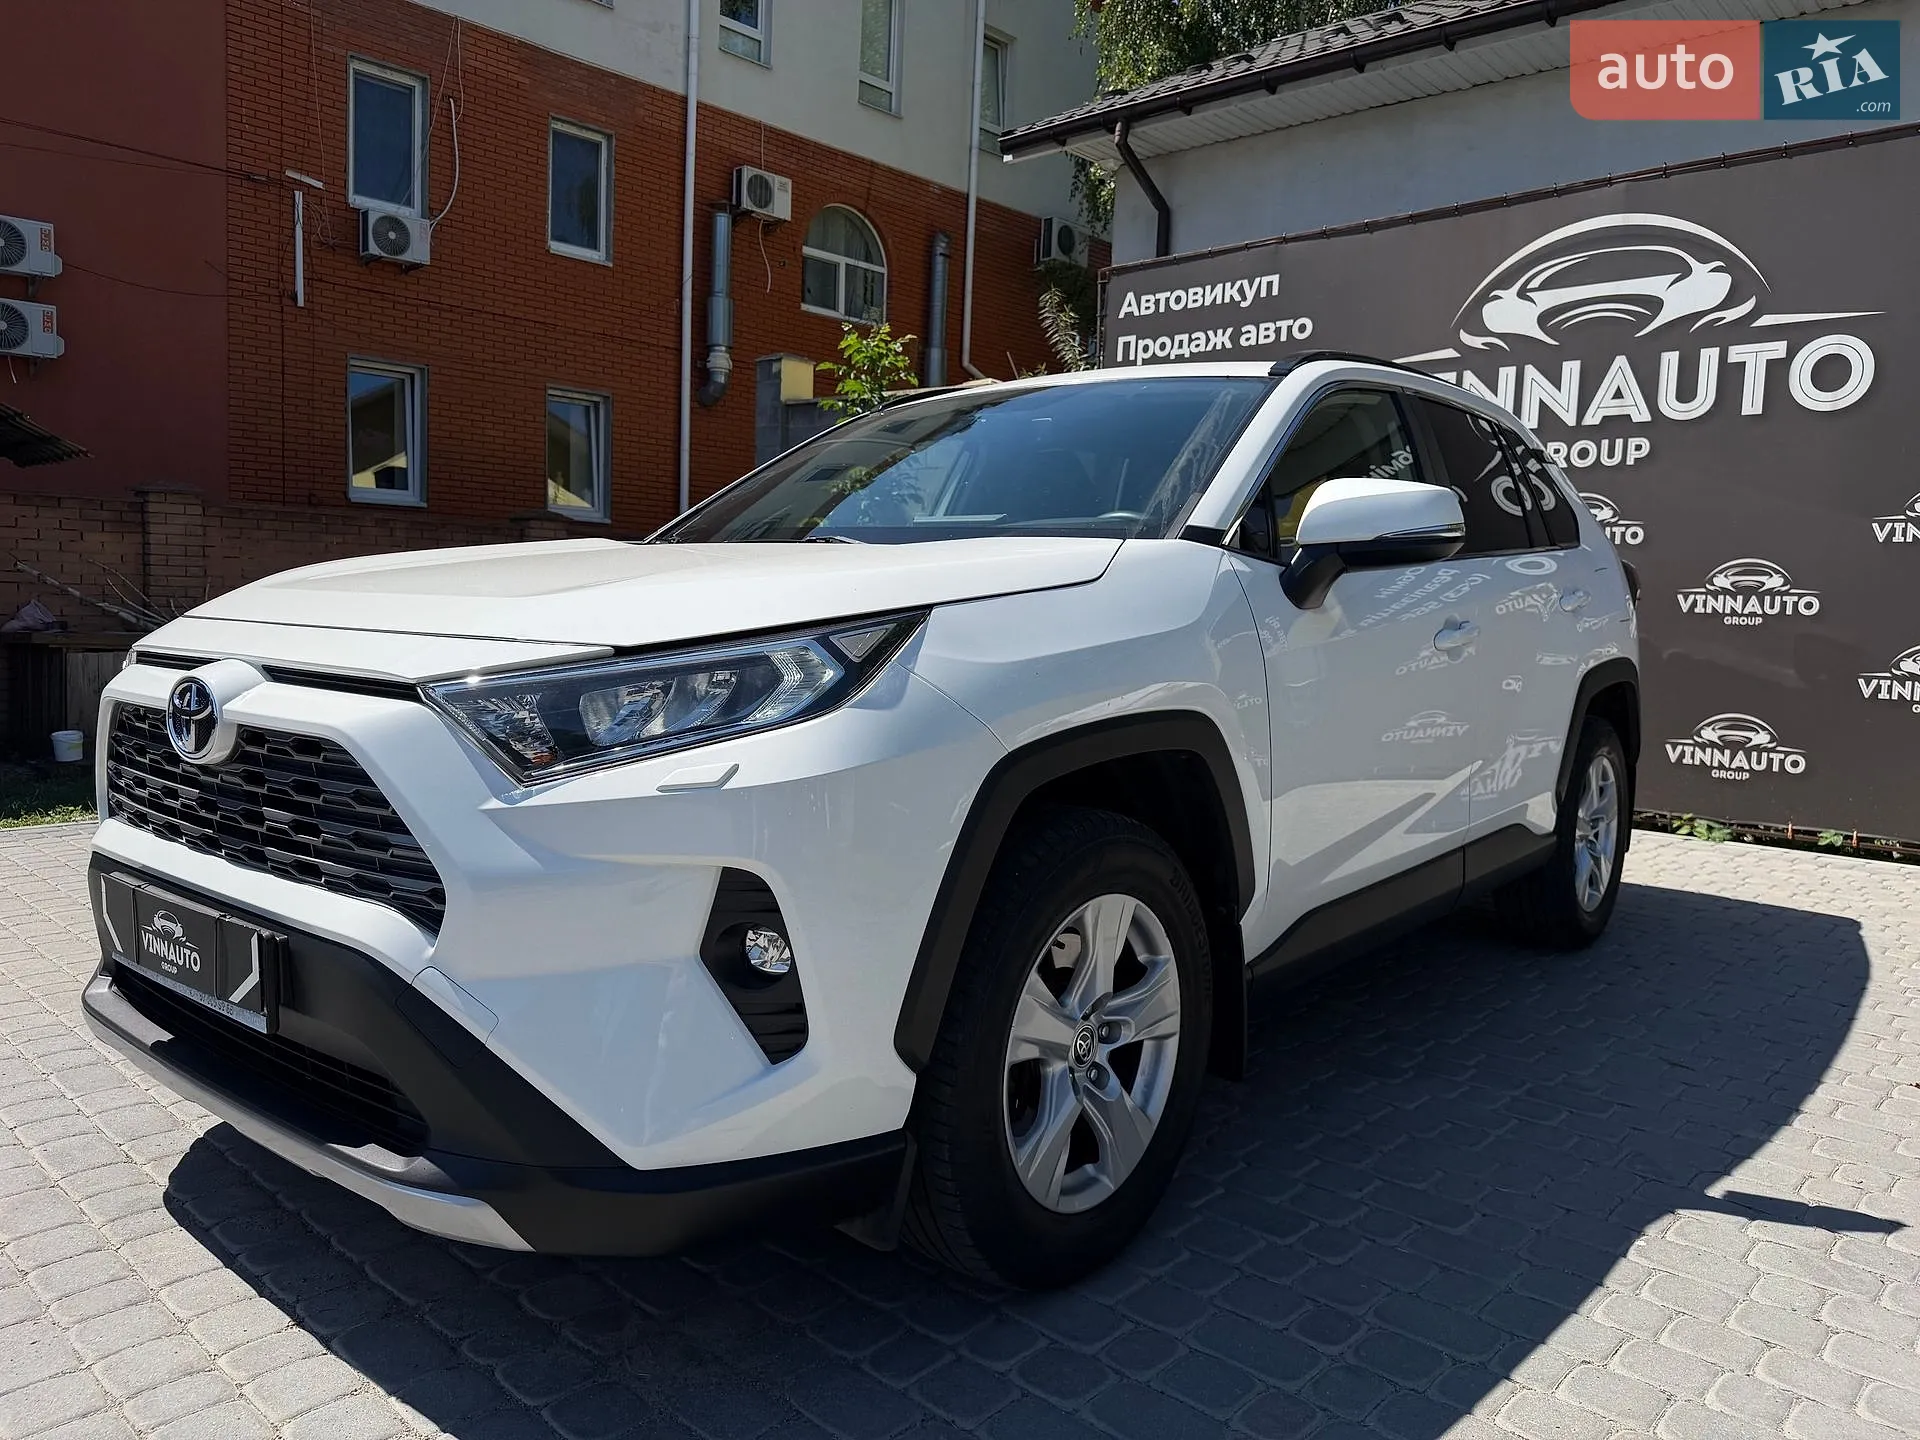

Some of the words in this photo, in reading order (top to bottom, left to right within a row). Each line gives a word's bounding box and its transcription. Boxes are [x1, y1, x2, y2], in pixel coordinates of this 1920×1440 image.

[1118, 274, 1280, 319] Автовикуп
[1116, 327, 1234, 366] Продаж
[1239, 317, 1314, 346] авто
[1436, 334, 1875, 430] NNAUTO
[1545, 436, 1650, 469] ROUP
[1677, 594, 1820, 616] VINNAUTO
[1723, 616, 1763, 626] GROUP
[1665, 744, 1806, 774] VINNAUTO
[1711, 769, 1750, 781] GROUP
[141, 930, 201, 972] VINNAUTO
[161, 962, 178, 974] GROUP
